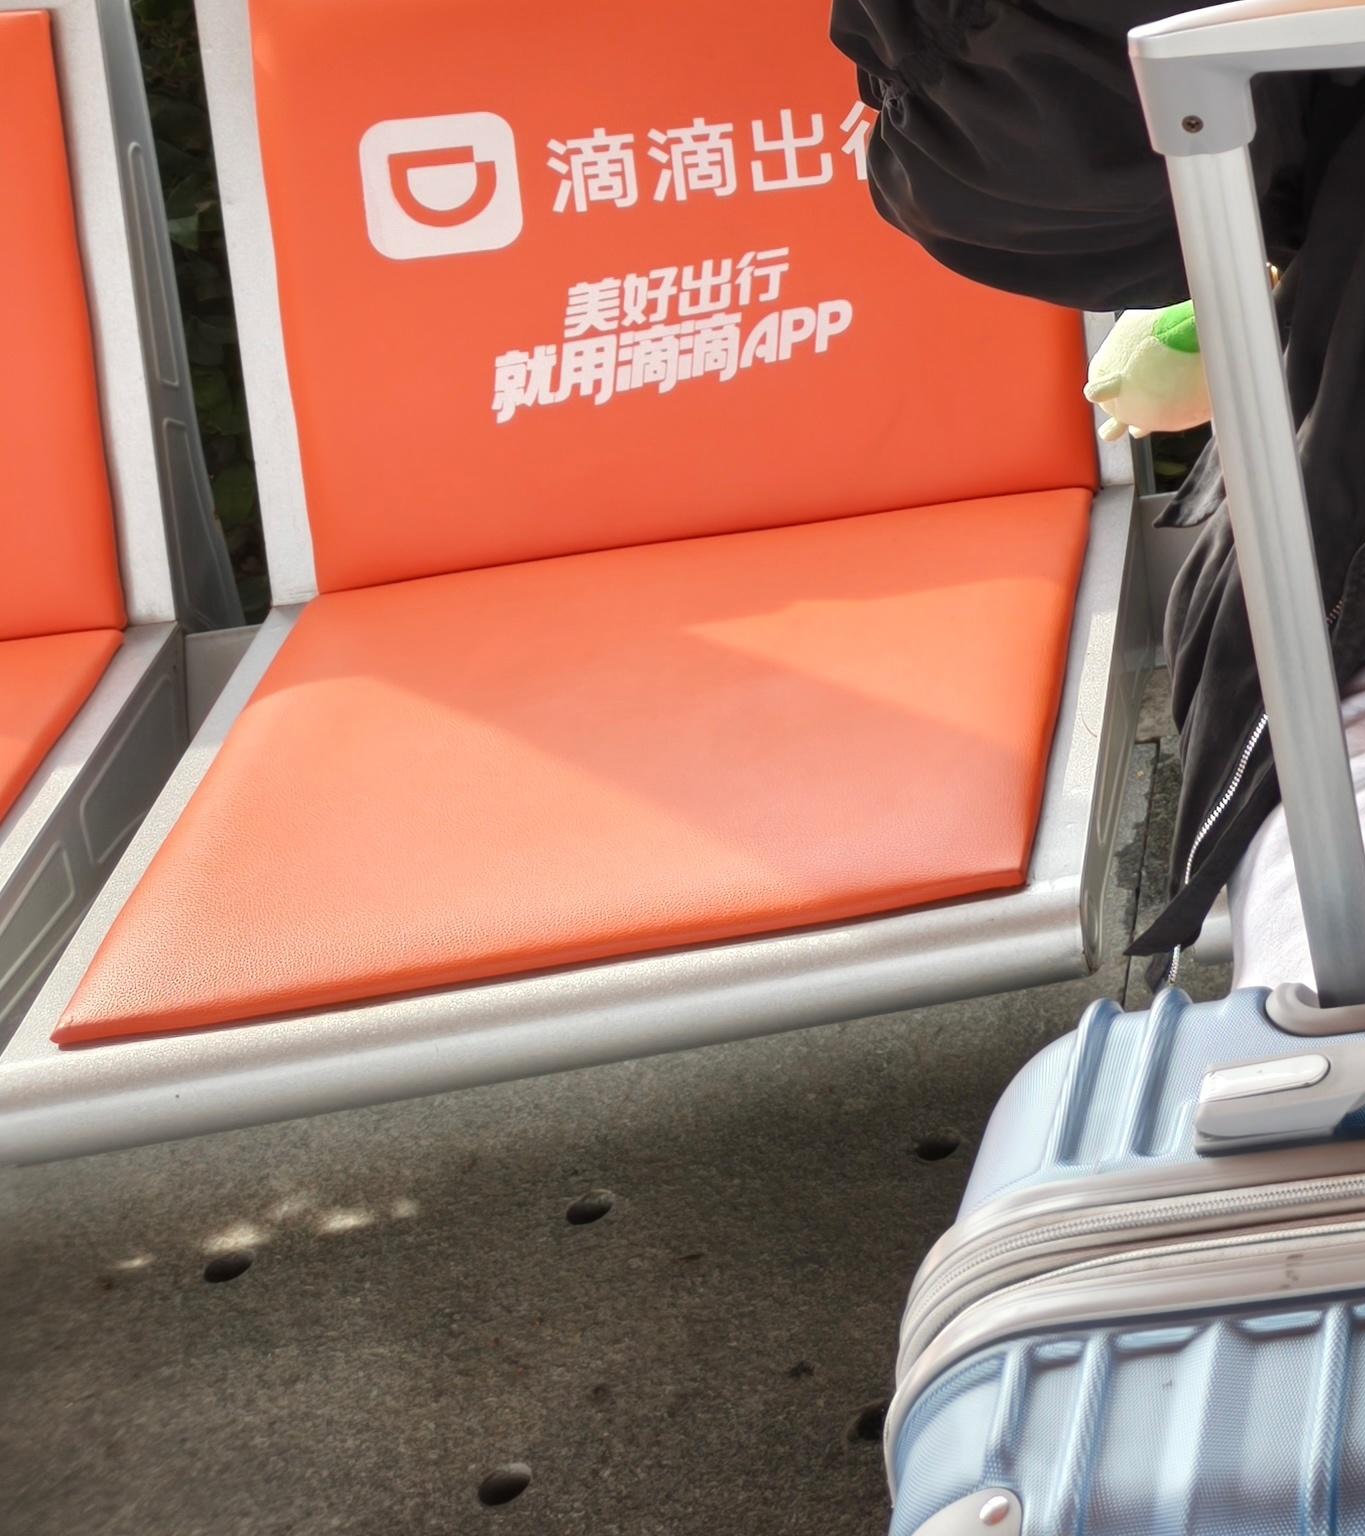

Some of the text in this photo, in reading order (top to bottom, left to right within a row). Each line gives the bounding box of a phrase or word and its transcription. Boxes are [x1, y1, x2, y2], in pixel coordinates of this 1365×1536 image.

[563, 247, 790, 339] 美好出行
[491, 298, 853, 425] 就用滴滴APP
